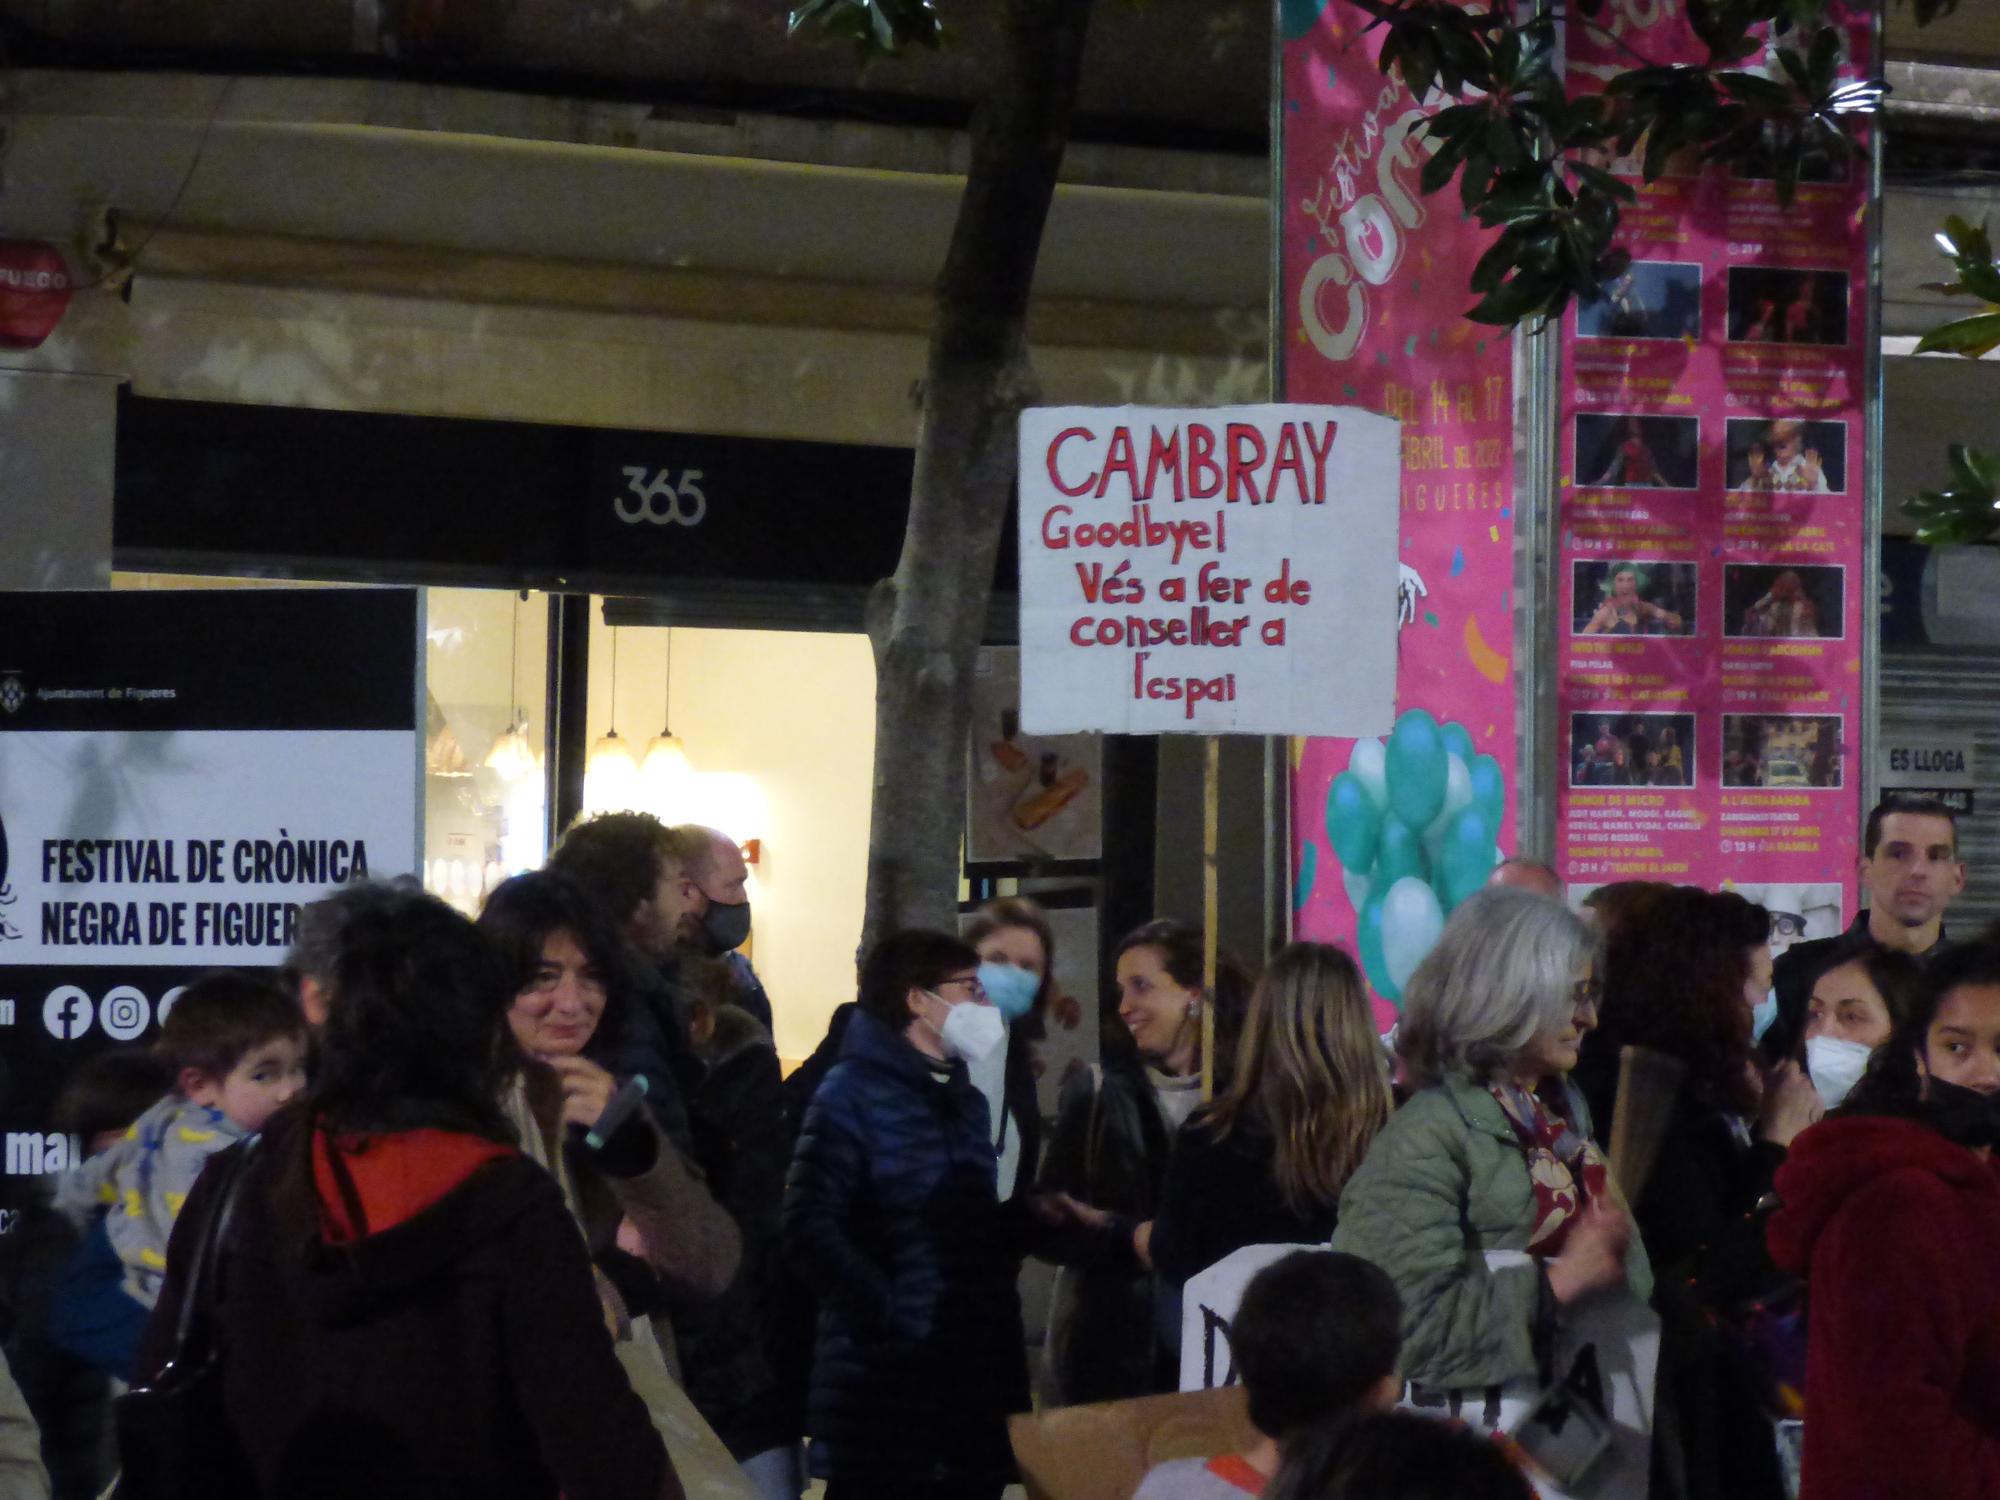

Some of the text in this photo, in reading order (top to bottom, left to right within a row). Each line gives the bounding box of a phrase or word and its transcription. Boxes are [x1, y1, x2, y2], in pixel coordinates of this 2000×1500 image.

[1046, 420, 1338, 505] CAMBRAY
[614, 466, 706, 526] 365
[1402, 481, 1503, 512] IGUERES
[1075, 558, 1311, 605] Vés a fer de
[1070, 606, 1286, 648] conseller a
[38, 687, 177, 701] Ajuntament de Figueres
[1890, 748, 1965, 772] ES LLOGA
[42, 828, 368, 884] FESTIVAL DE CRÒNICA
[40, 901, 302, 947] NEGRA DE FIGUER
